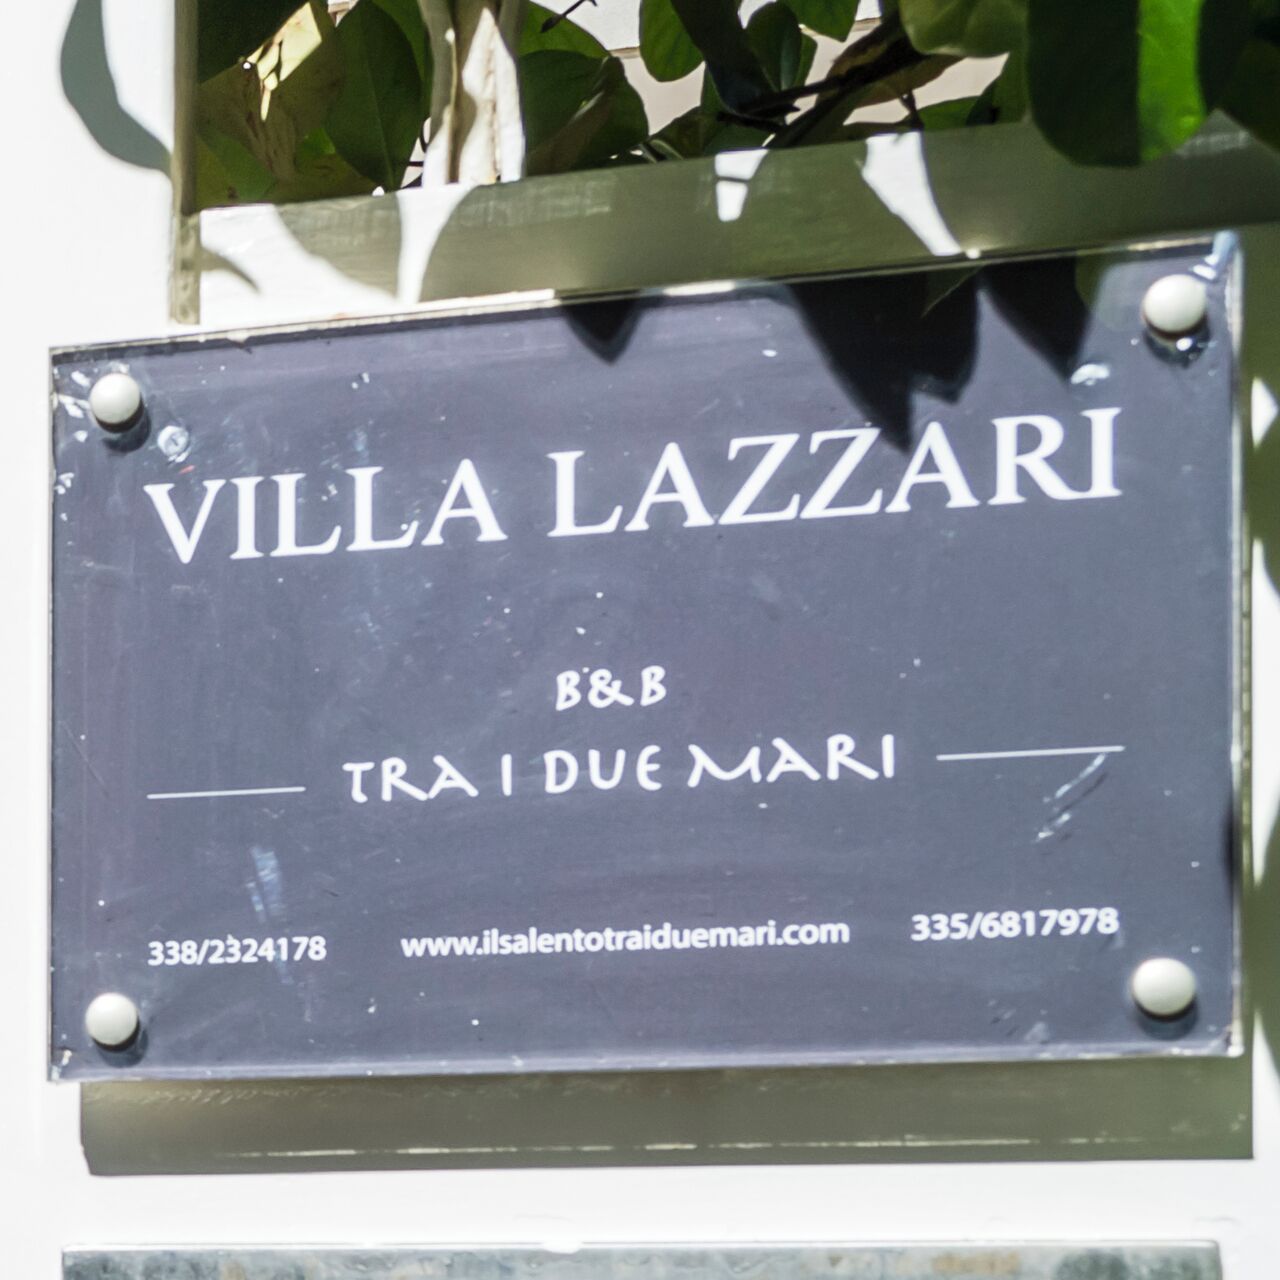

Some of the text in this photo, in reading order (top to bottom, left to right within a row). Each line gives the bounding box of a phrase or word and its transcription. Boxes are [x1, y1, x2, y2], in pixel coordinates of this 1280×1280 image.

[143, 407, 1123, 565] VILLA LAZZARI
[555, 665, 667, 712] B&B
[343, 733, 896, 804] TRA I DUE MARI
[400, 918, 851, 959] www.ilsalentotraiduemari.com
[910, 906, 1120, 942] 335/6817978
[147, 934, 328, 967] 338/2324178
